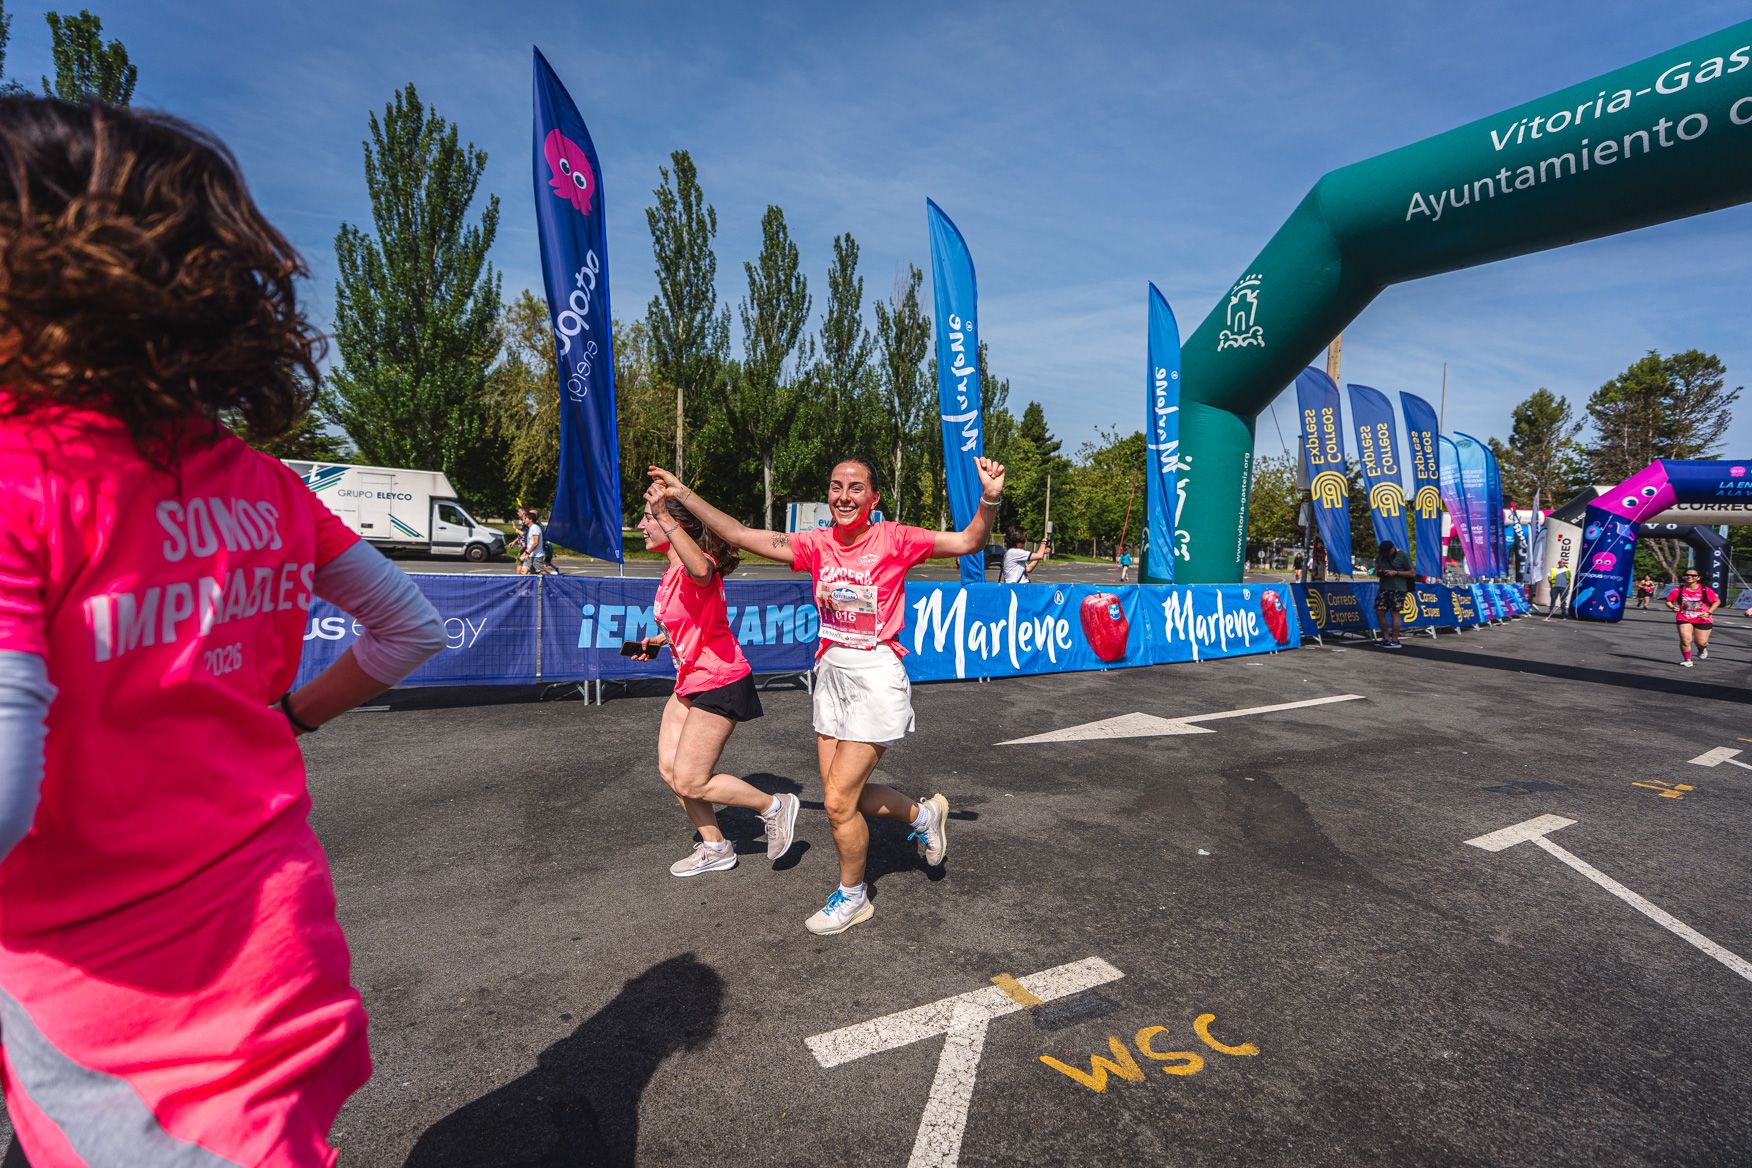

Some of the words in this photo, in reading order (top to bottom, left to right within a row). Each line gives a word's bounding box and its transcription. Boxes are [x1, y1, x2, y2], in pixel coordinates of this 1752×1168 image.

[1405, 112, 1709, 222] Ayuntamiento
[337, 489, 373, 499] GRUPO
[377, 491, 413, 501] ELEYCO
[1236, 452, 1250, 563] www.vitoria-gasteiz.org
[1719, 481, 1734, 489] LA
[1712, 550, 1721, 588] OLVO
[1039, 1013, 1260, 1094] WSC
